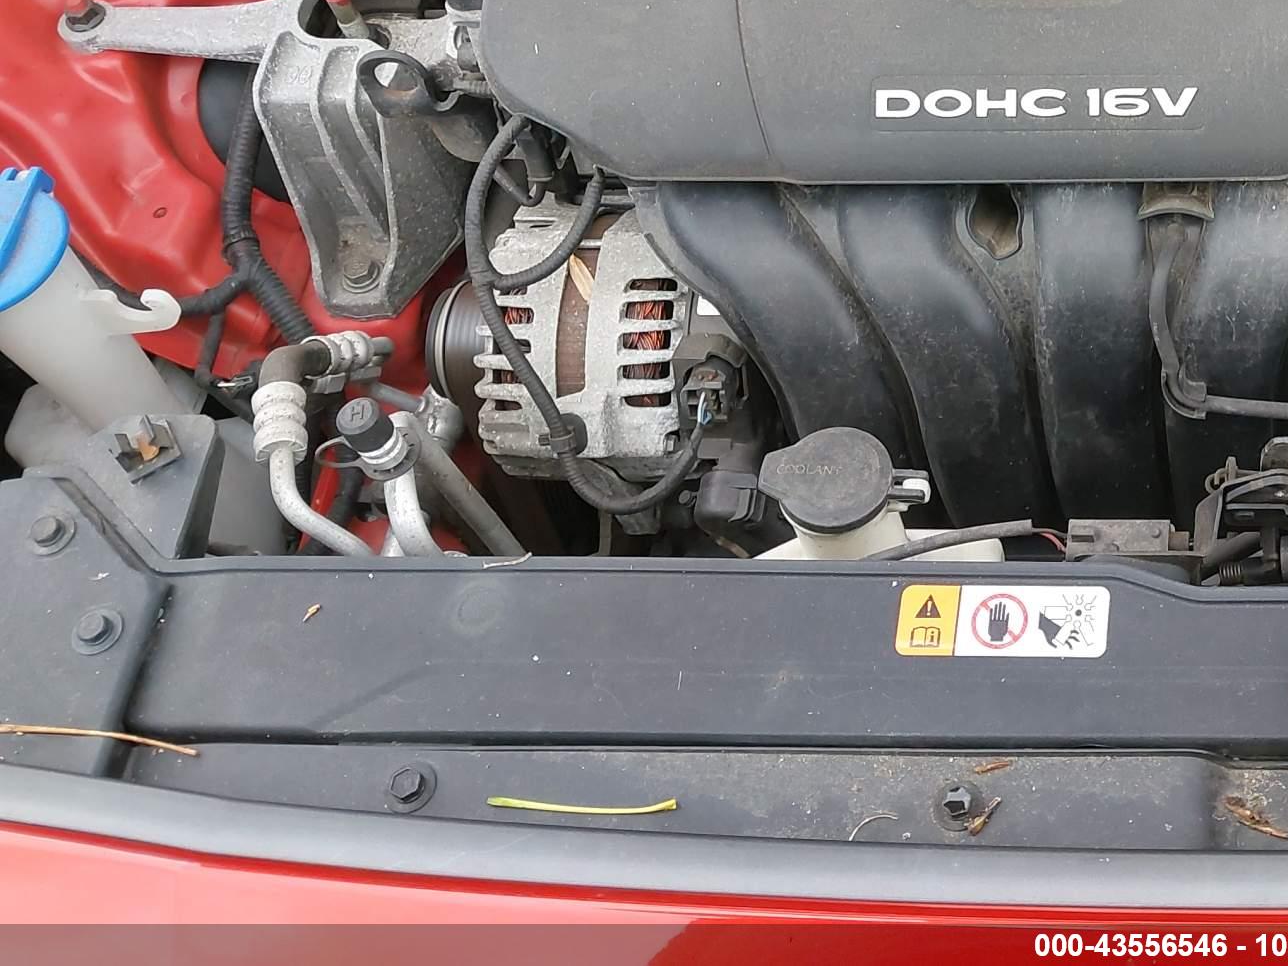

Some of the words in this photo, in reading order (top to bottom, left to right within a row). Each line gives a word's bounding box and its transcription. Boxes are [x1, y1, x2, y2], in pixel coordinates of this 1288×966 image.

[875, 88, 1067, 118] DOHC
[1086, 87, 1199, 117] 16V
[350, 403, 365, 422] H
[776, 463, 843, 475] COOLANT
